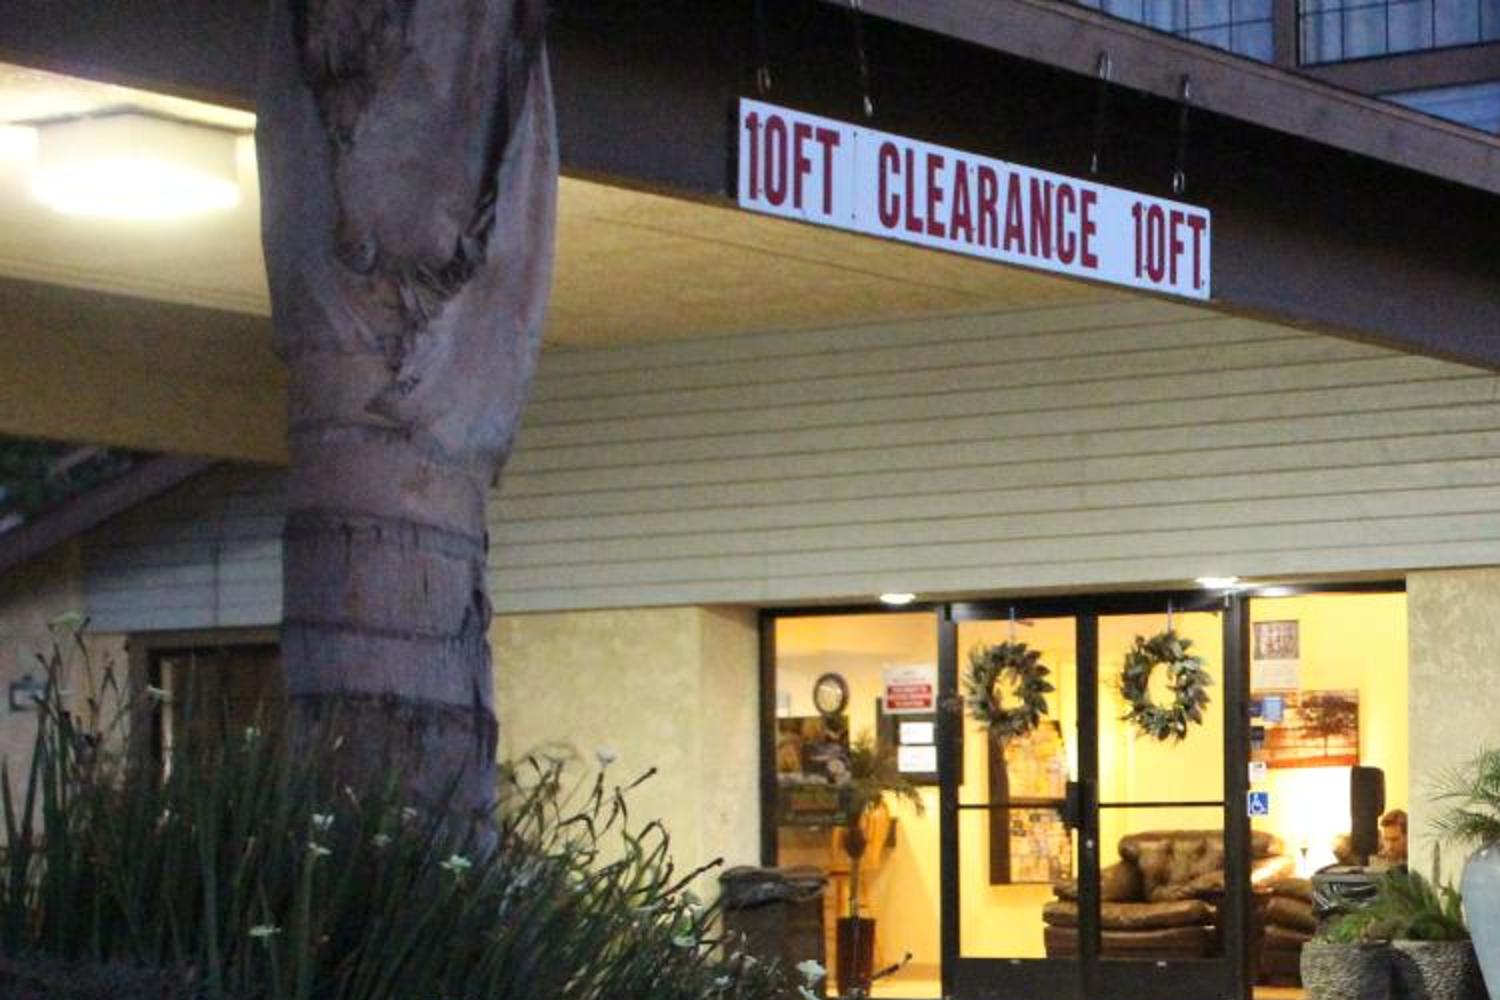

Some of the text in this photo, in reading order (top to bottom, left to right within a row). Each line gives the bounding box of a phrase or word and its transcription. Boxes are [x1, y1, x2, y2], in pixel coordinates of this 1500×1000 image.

[745, 111, 1206, 289] 10FT CLEARANCE 10FT
